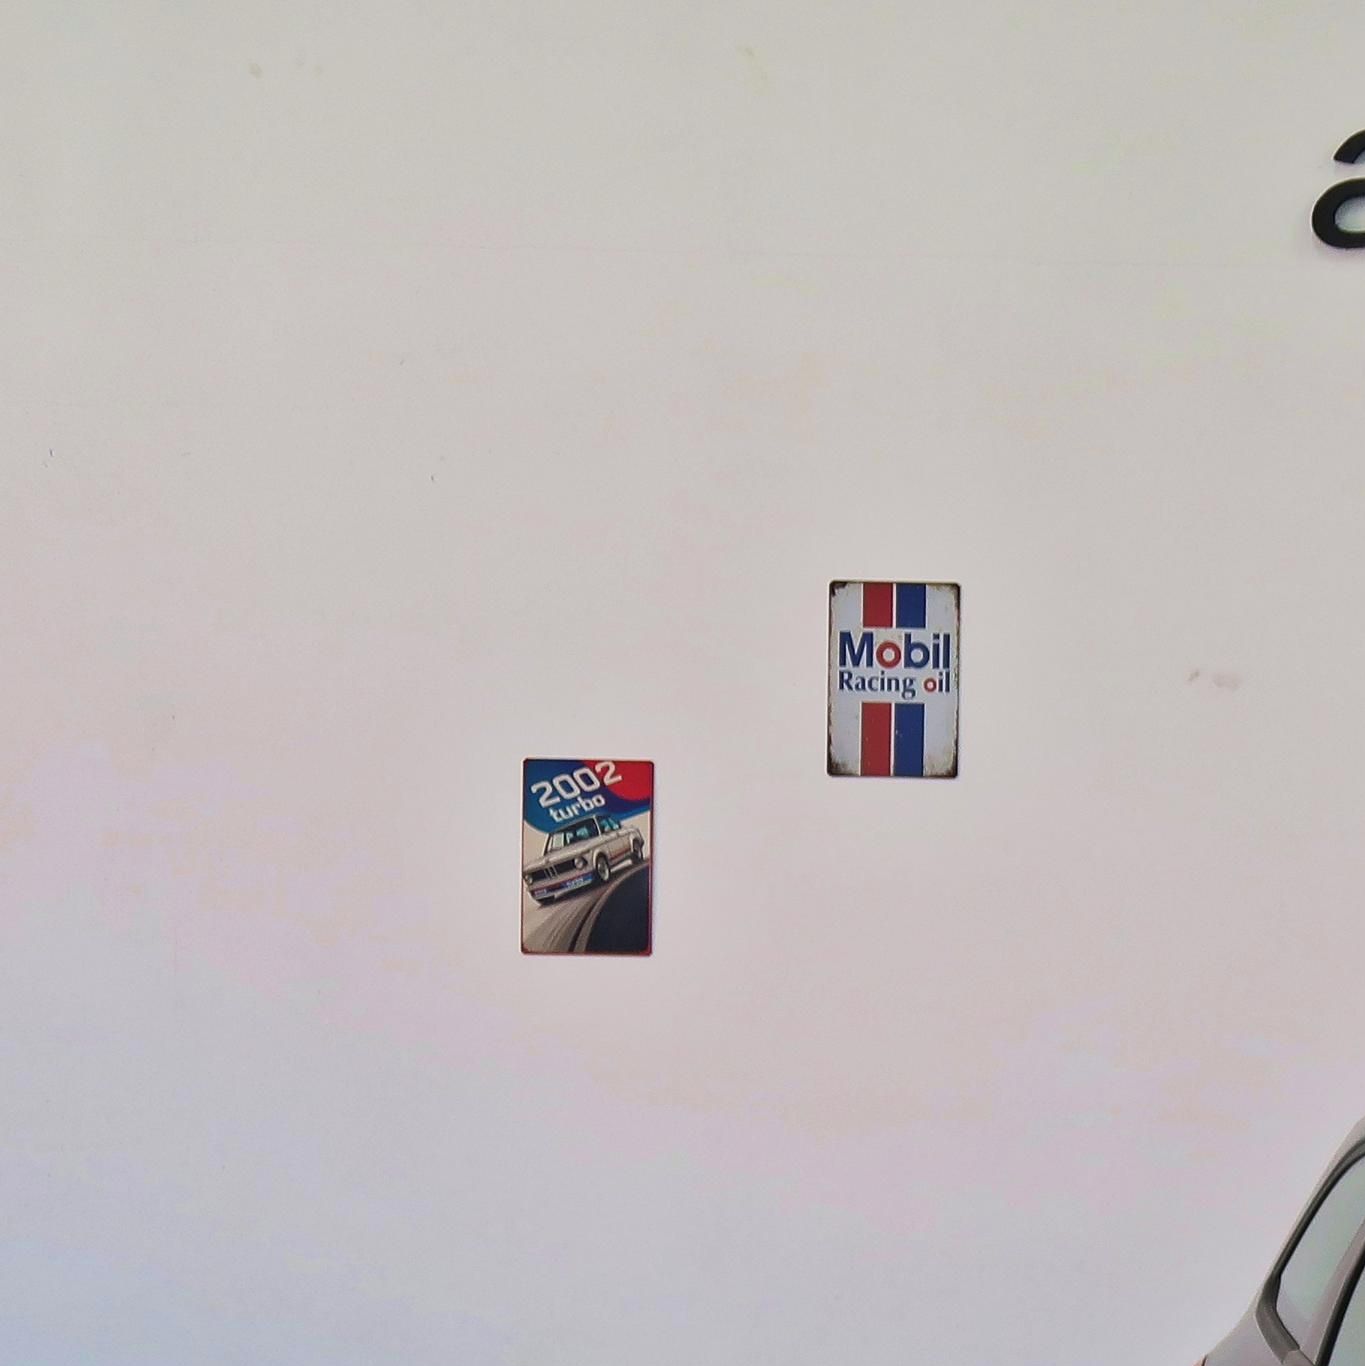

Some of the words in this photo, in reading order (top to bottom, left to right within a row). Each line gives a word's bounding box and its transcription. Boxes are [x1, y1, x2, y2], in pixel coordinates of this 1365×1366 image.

[838, 630, 951, 670] Mobil
[838, 670, 917, 700] Racing
[923, 671, 951, 694] oil
[530, 760, 624, 809] 2002
[548, 794, 606, 823] turbo
